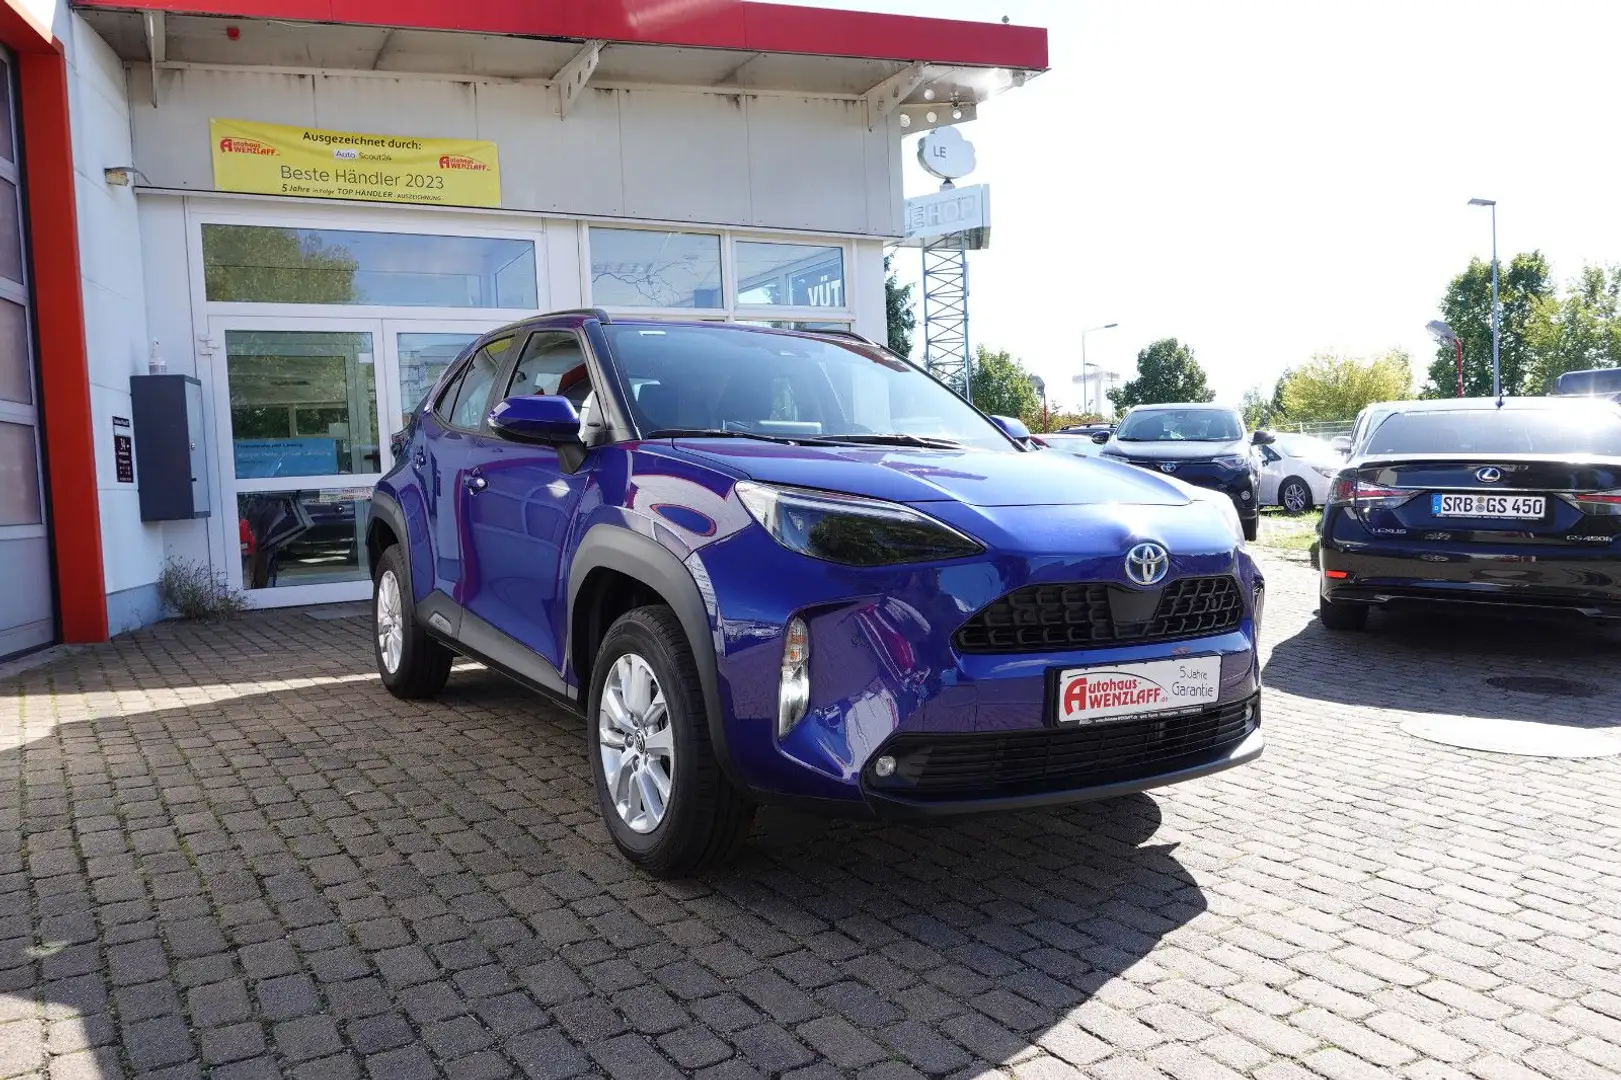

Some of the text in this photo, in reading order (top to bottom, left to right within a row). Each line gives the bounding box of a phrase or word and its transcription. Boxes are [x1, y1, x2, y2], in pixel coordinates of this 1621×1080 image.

[303, 131, 422, 150] Ausgezeichnet durch:
[933, 145, 947, 159] LE
[281, 164, 445, 189] Beste Händler 2023
[281, 183, 288, 192] 5
[289, 184, 310, 193] Jahre
[337, 188, 353, 196] TOP
[355, 189, 393, 198] HÄNDLER
[1442, 496, 1543, 515] SRB GS 450
[1372, 527, 1407, 535] LEXUS
[1179, 665, 1208, 680] 5 Jahre
[1172, 681, 1214, 697] Garantie
